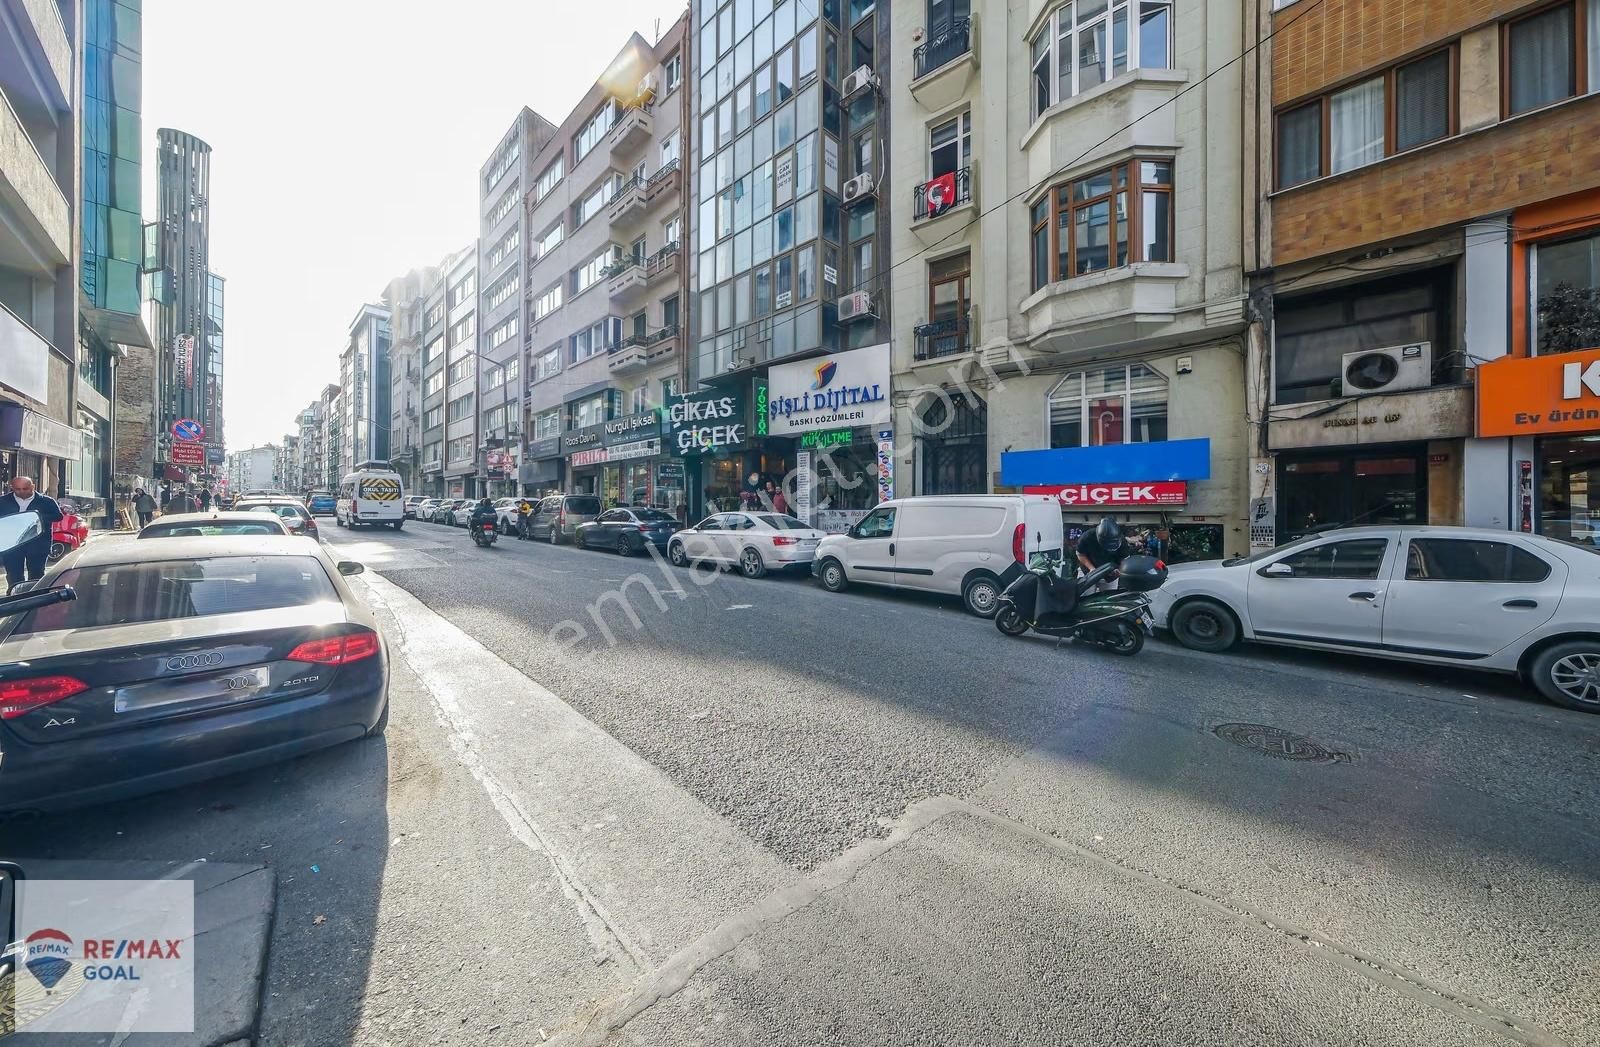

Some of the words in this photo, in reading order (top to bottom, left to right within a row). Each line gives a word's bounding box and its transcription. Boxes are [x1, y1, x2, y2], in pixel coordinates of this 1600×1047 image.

[770, 391, 809, 421] ŞİŞLİ
[813, 384, 885, 412] DİJİTAL
[670, 397, 733, 429] ÇİKAS
[789, 417, 813, 427] BASKI
[815, 411, 864, 425] ÇÖZÜMLERİ
[1514, 412, 1541, 426] Ev
[677, 424, 741, 455] ÇİÇEK
[1060, 485, 1156, 505] ÇİÇEK
[43, 717, 77, 729] A4
